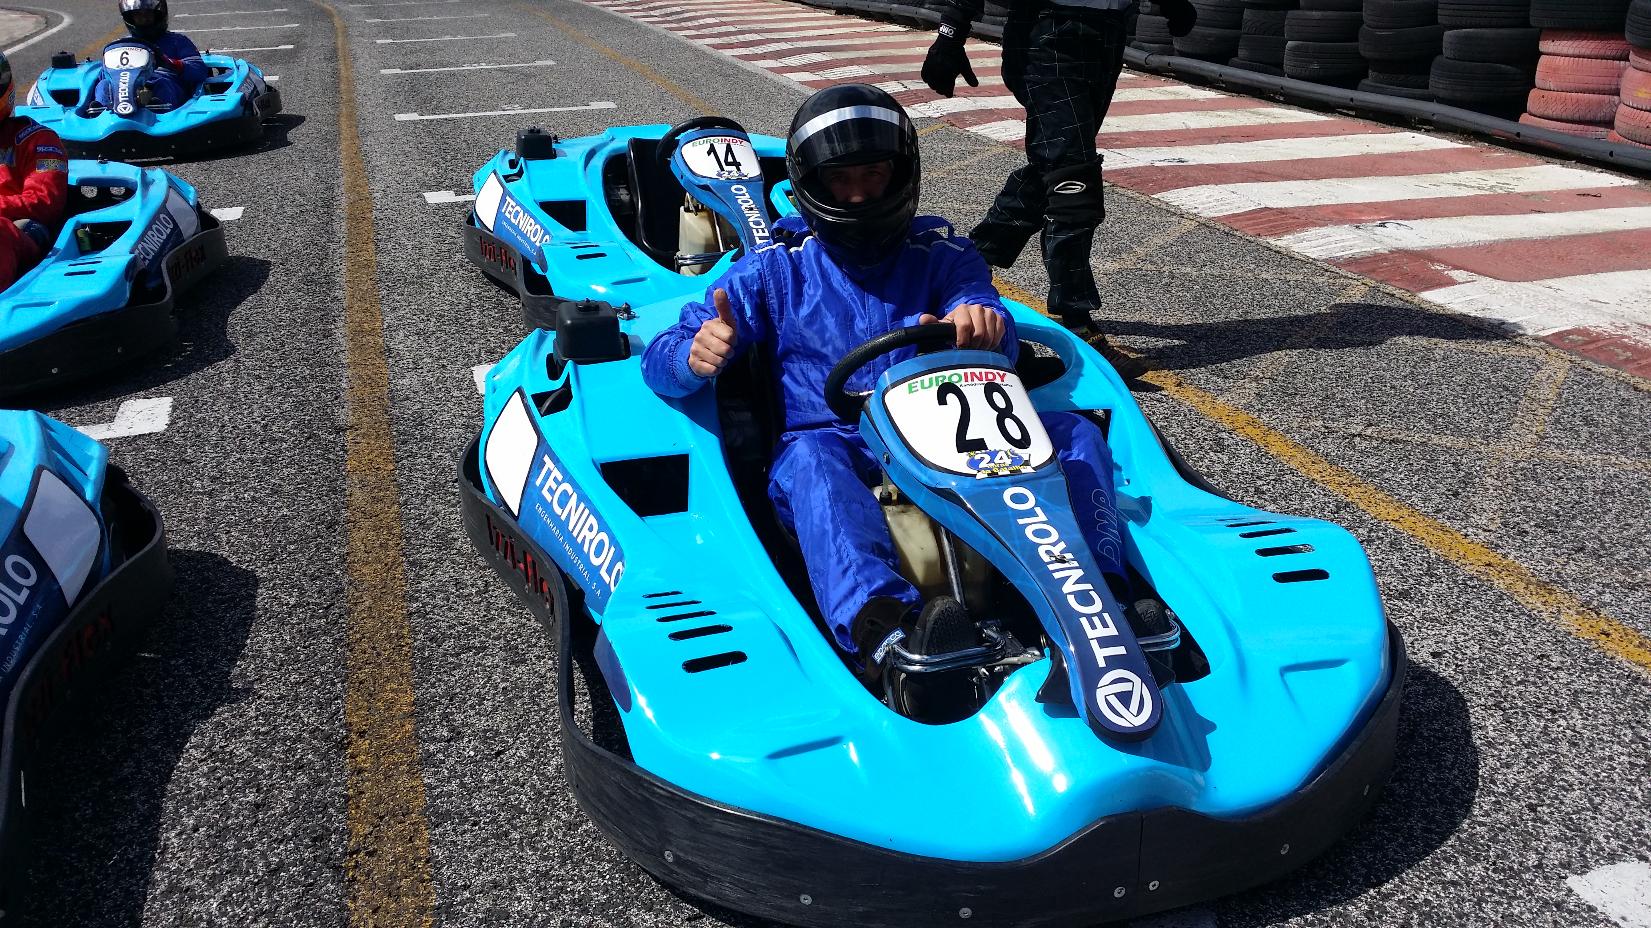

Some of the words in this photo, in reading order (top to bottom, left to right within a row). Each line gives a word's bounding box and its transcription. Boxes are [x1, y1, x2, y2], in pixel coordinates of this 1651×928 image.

[119, 50, 130, 67] 6
[691, 137, 744, 147] EUROINDY
[706, 142, 742, 171] 14
[907, 371, 1008, 395] EUROINDY
[936, 381, 1032, 454] 28
[974, 450, 1012, 469] 24
[534, 502, 564, 544] ENGENHARIA
[1003, 486, 1128, 668] TECNIROLO
